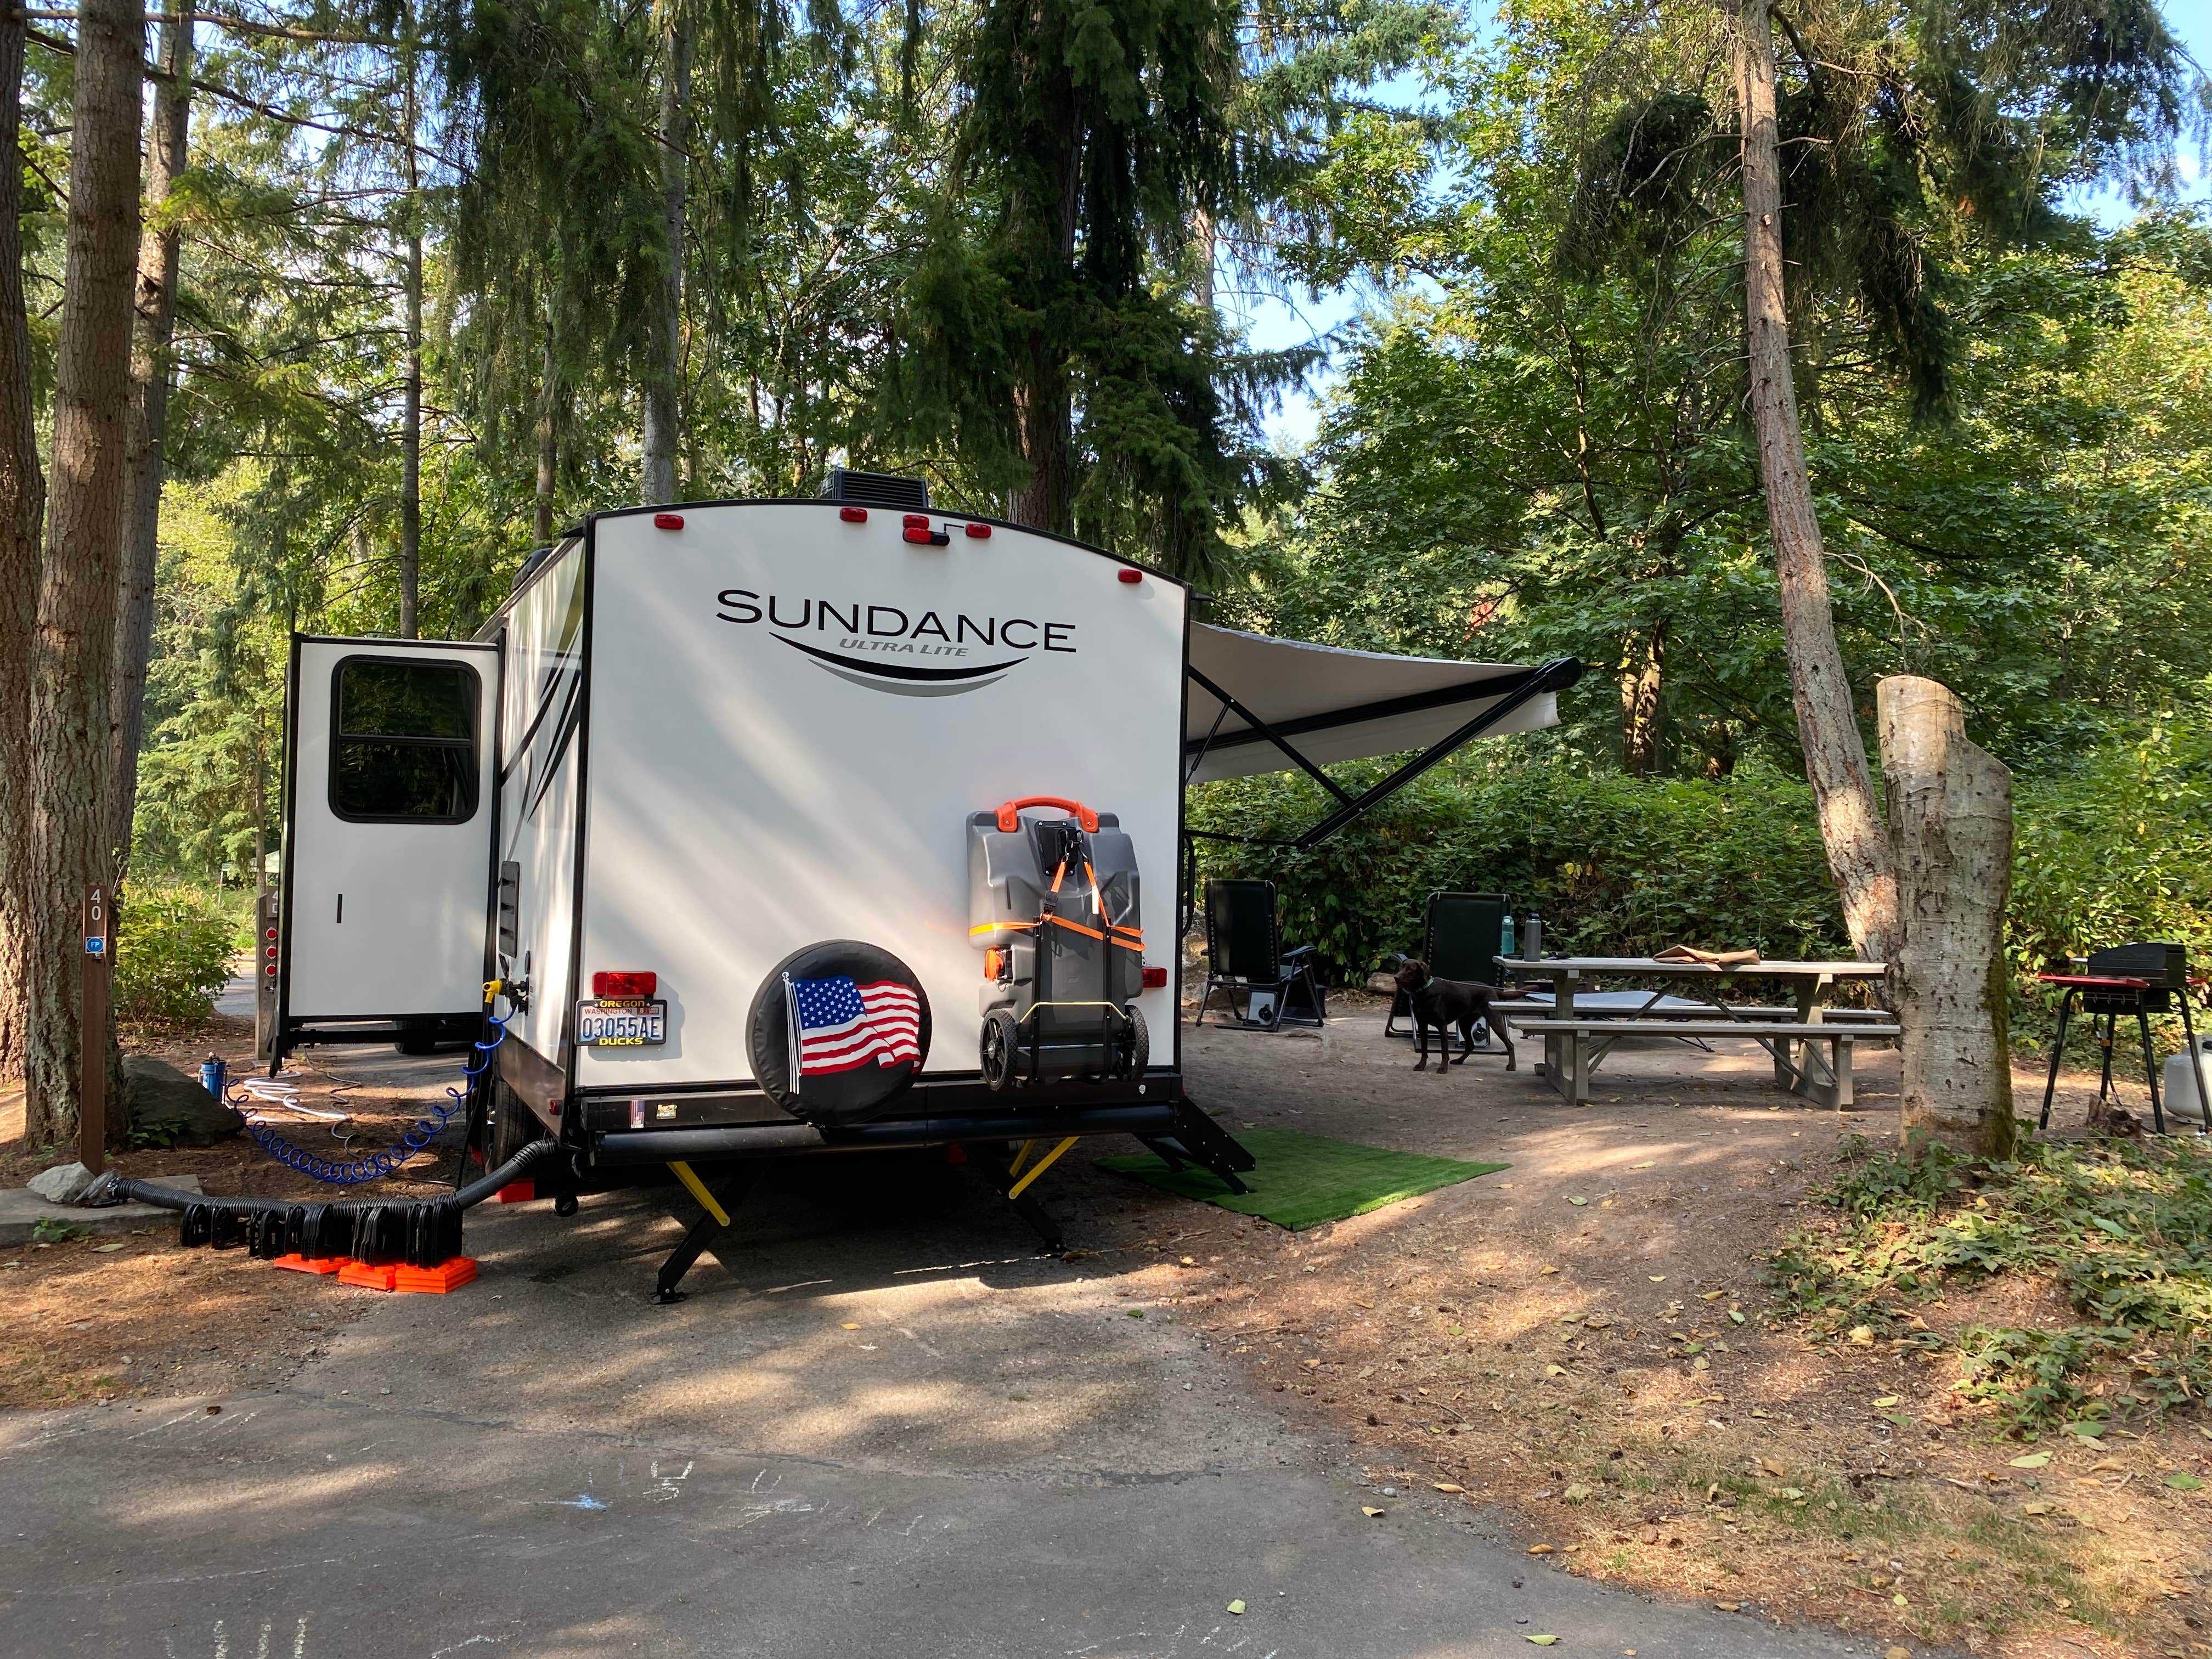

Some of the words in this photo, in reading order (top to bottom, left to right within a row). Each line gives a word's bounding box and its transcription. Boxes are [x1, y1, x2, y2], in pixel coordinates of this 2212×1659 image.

[715, 589, 1077, 653] SUNDANCE
[839, 638, 915, 653] ULTRA
[919, 644, 969, 657] LITE
[91, 889, 101, 921] 40
[583, 1017, 660, 1037] 03055AE
[599, 1037, 644, 1046] DUCKS
